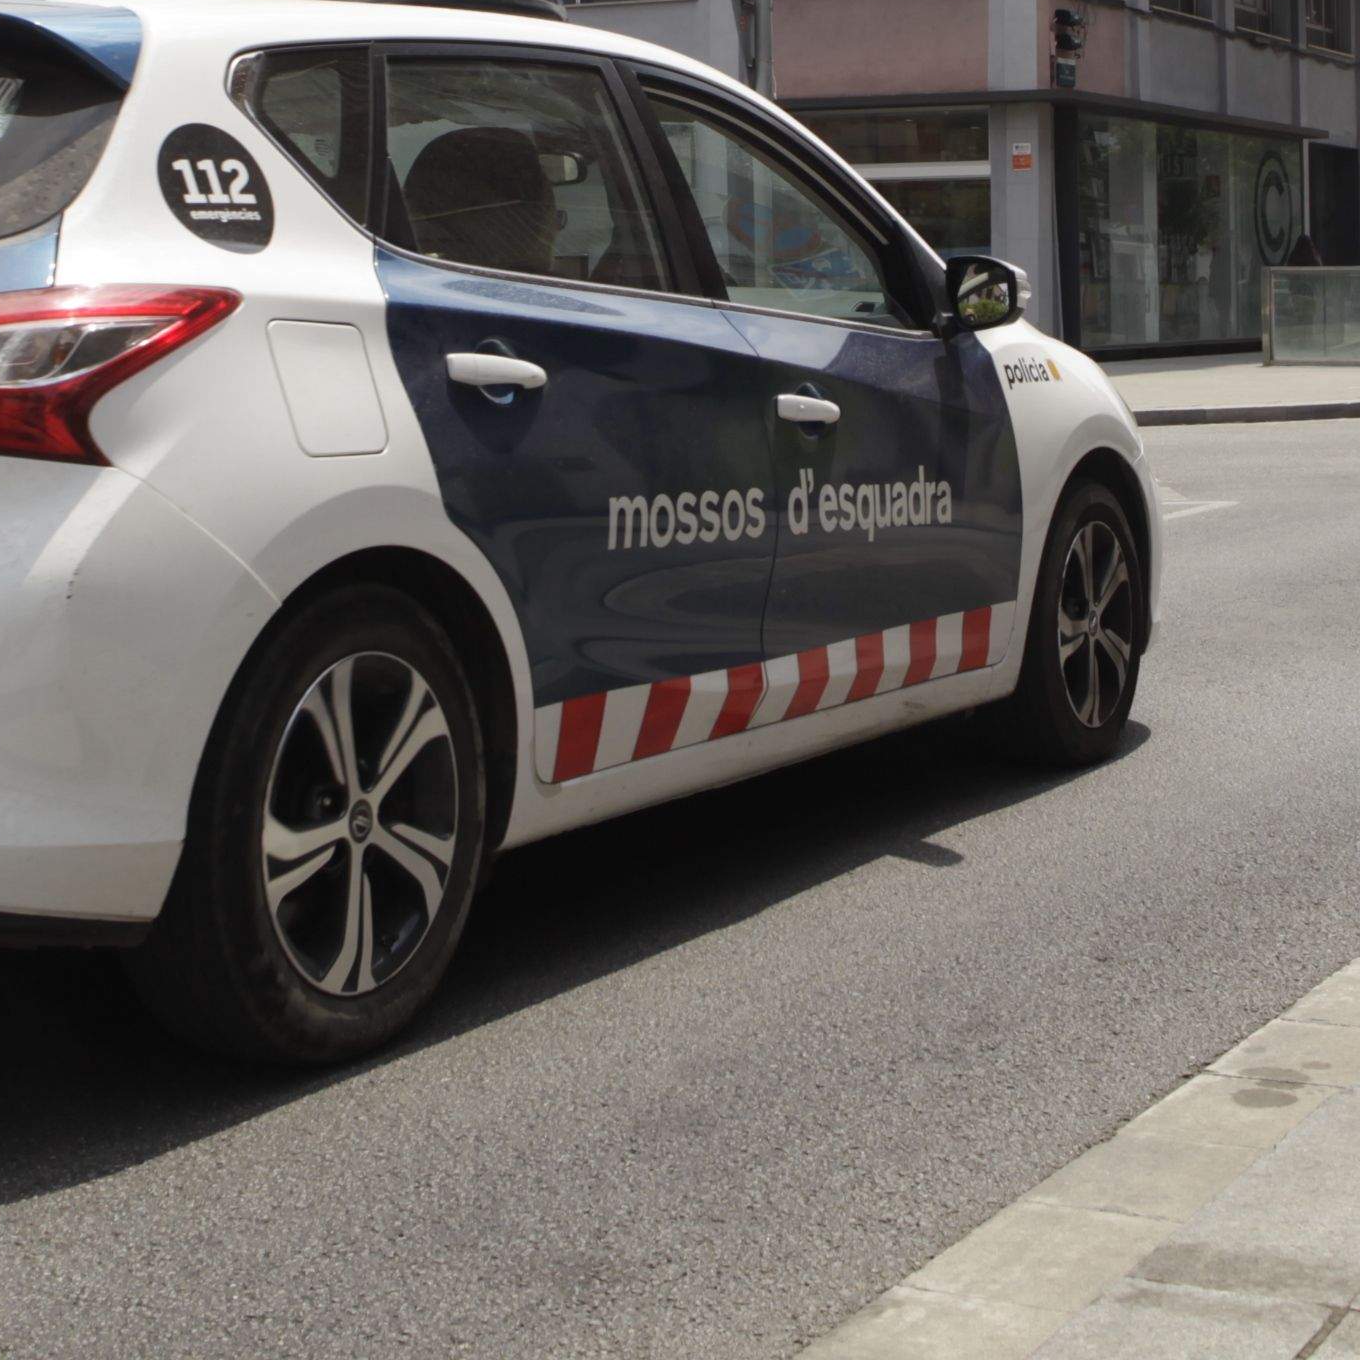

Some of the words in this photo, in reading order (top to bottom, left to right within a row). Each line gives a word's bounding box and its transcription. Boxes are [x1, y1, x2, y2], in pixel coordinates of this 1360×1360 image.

[171, 159, 258, 204] 112
[1004, 357, 1050, 390] policia
[607, 487, 766, 550] mossos
[788, 465, 953, 542] d'esquadra
